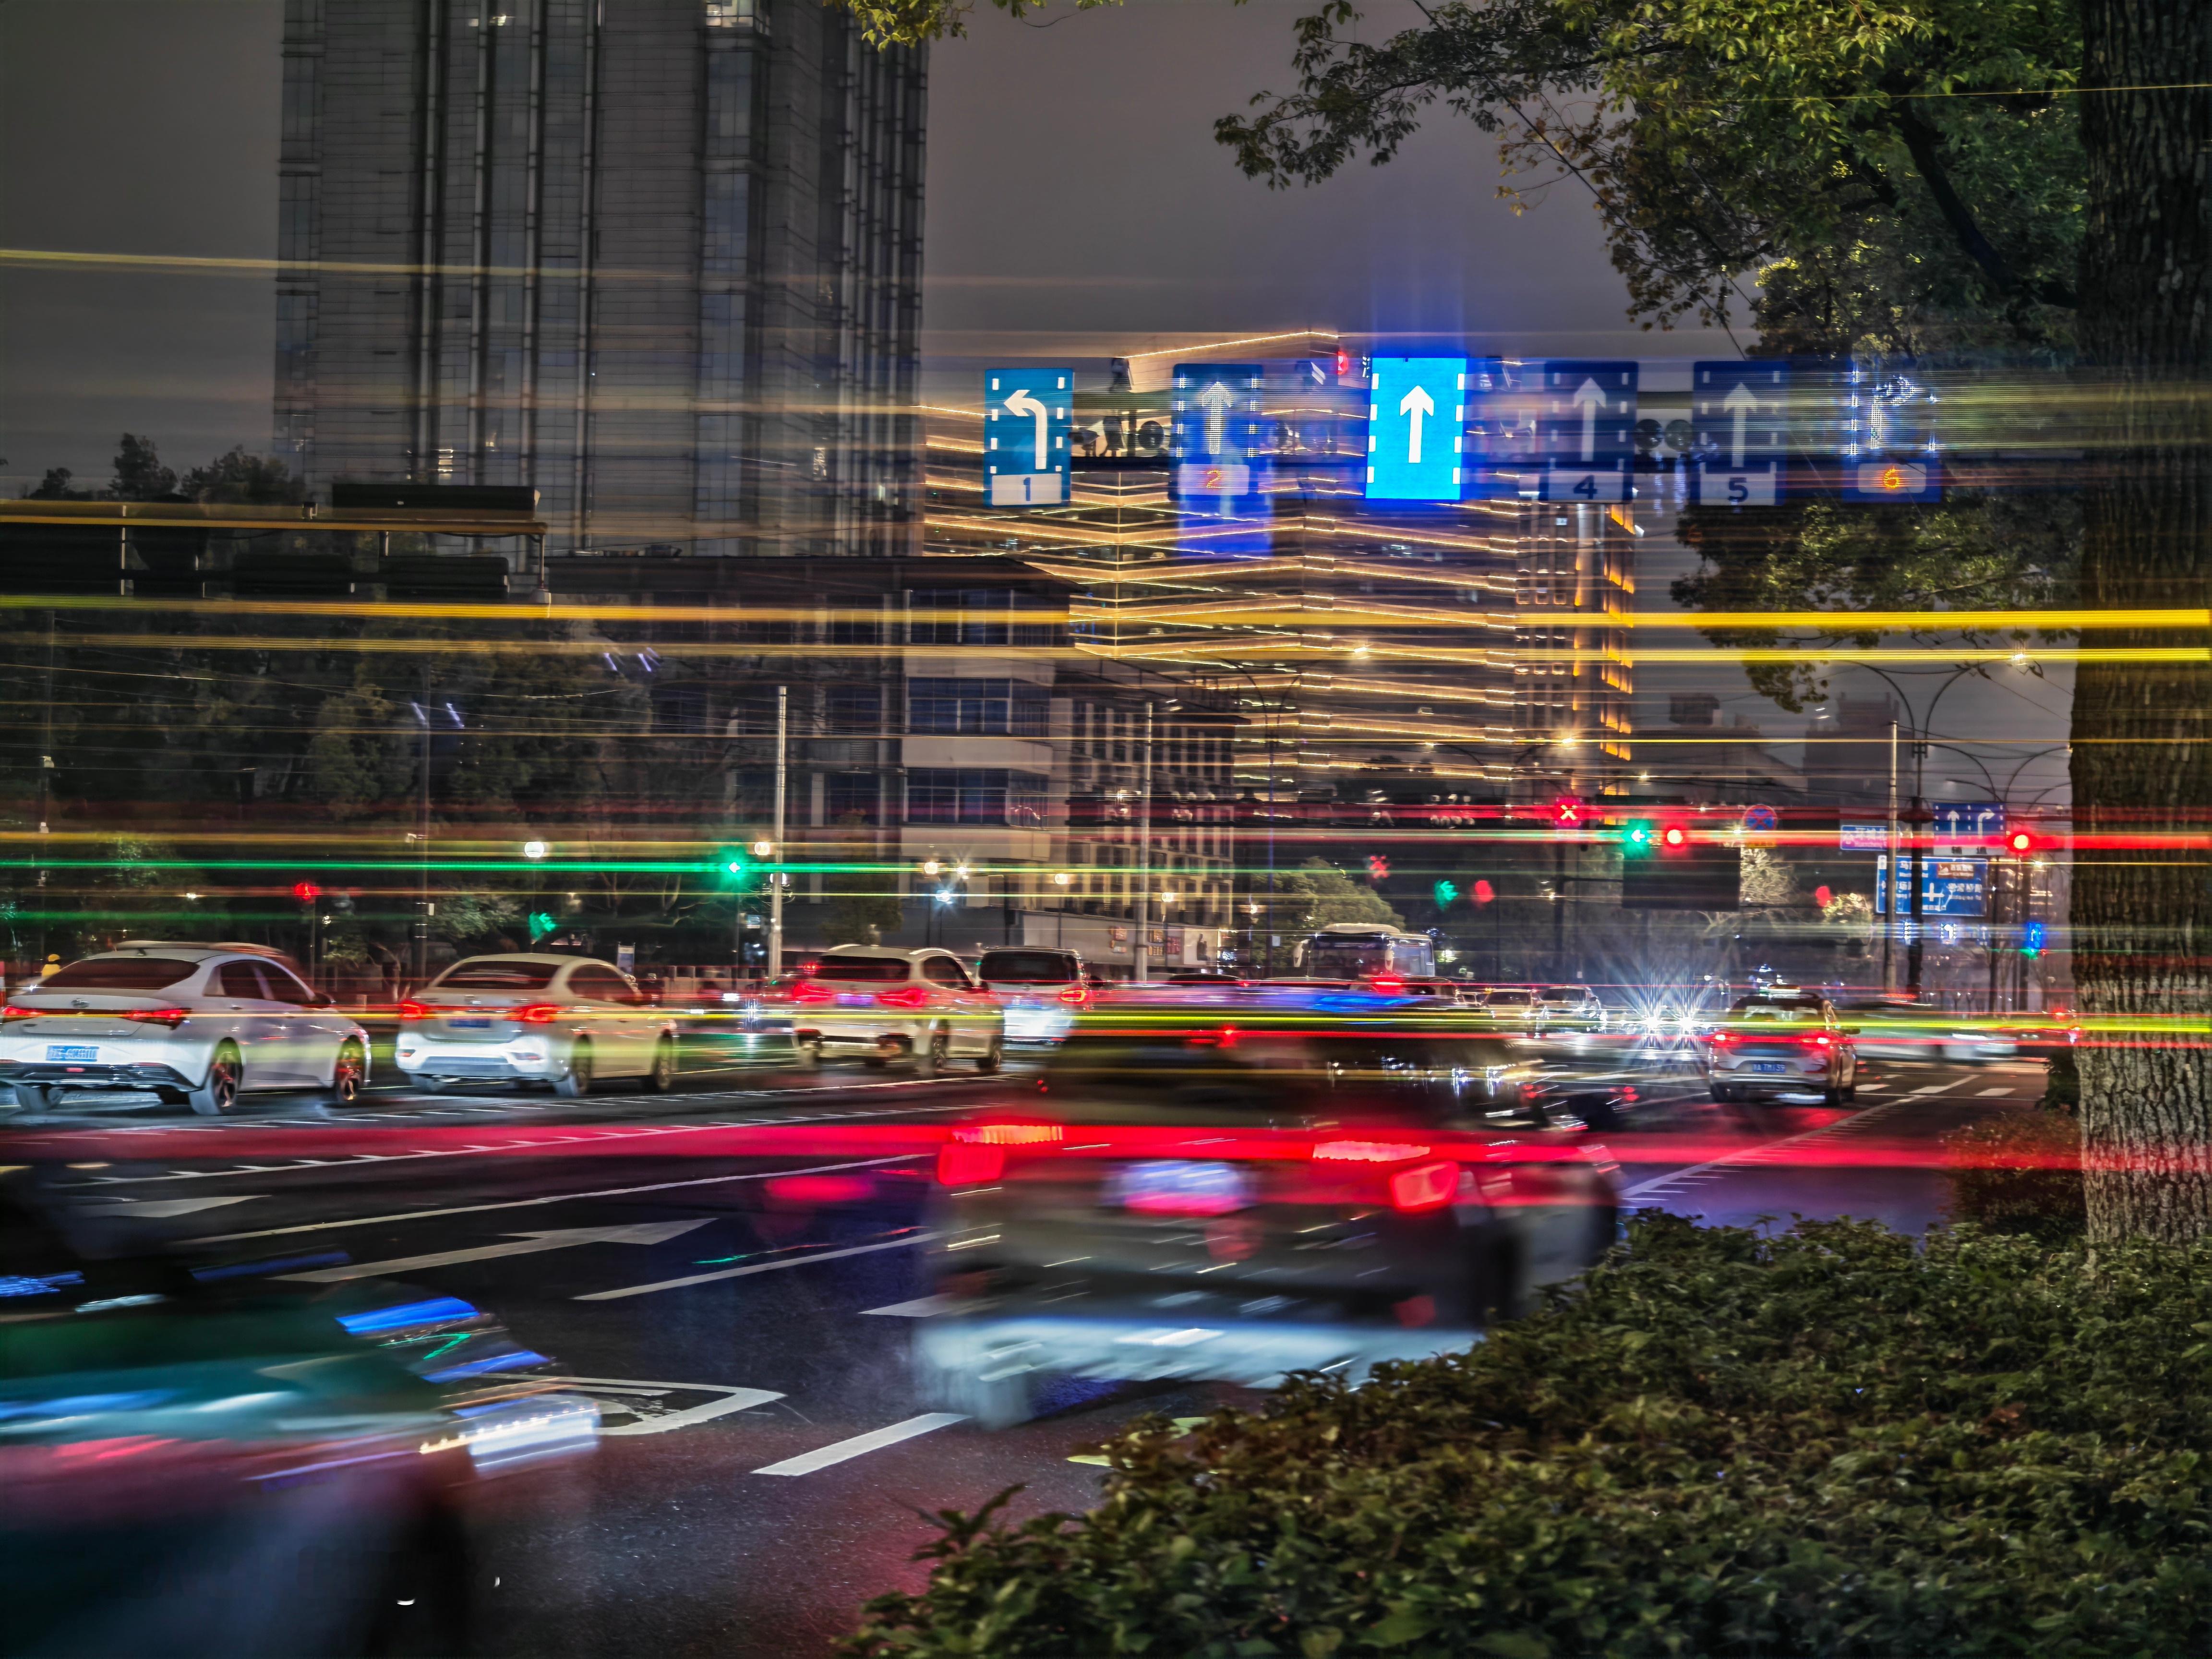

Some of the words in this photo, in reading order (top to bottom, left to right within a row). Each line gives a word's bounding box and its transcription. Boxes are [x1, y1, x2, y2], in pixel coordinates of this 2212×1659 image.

[1023, 477, 1031, 502] 1
[1206, 469, 1222, 489] 2
[1574, 474, 1599, 500] 4
[1728, 477, 1749, 503] 5
[1884, 468, 1900, 489] 6
